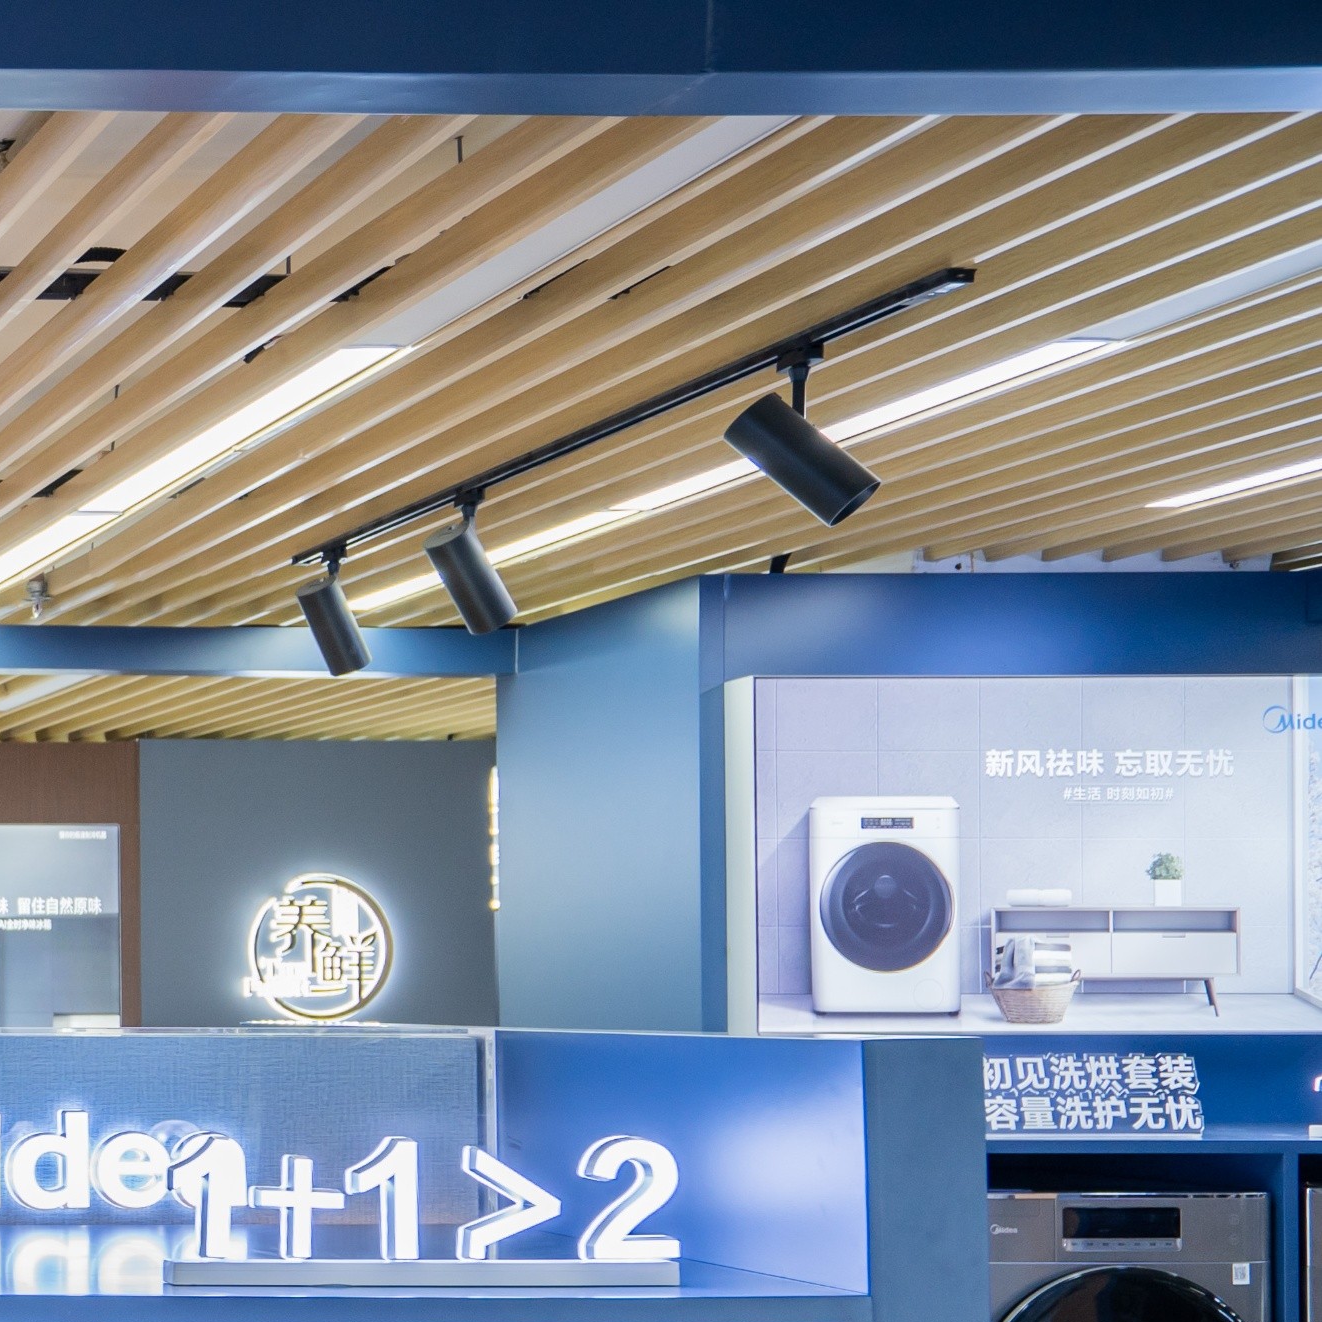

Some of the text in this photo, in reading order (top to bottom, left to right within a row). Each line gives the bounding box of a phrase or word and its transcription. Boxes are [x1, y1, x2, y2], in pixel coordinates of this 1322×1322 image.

[985, 749, 1235, 779] 新风祛味 忘取无忧
[1063, 786, 1175, 801] #生活 时刻如初#
[17, 896, 103, 916] 留住自然原味
[983, 1055, 1199, 1092] 初见洗烘套装
[985, 1095, 1203, 1131] 容量洗护无忧
[990, 1223, 1018, 1235] Midea
